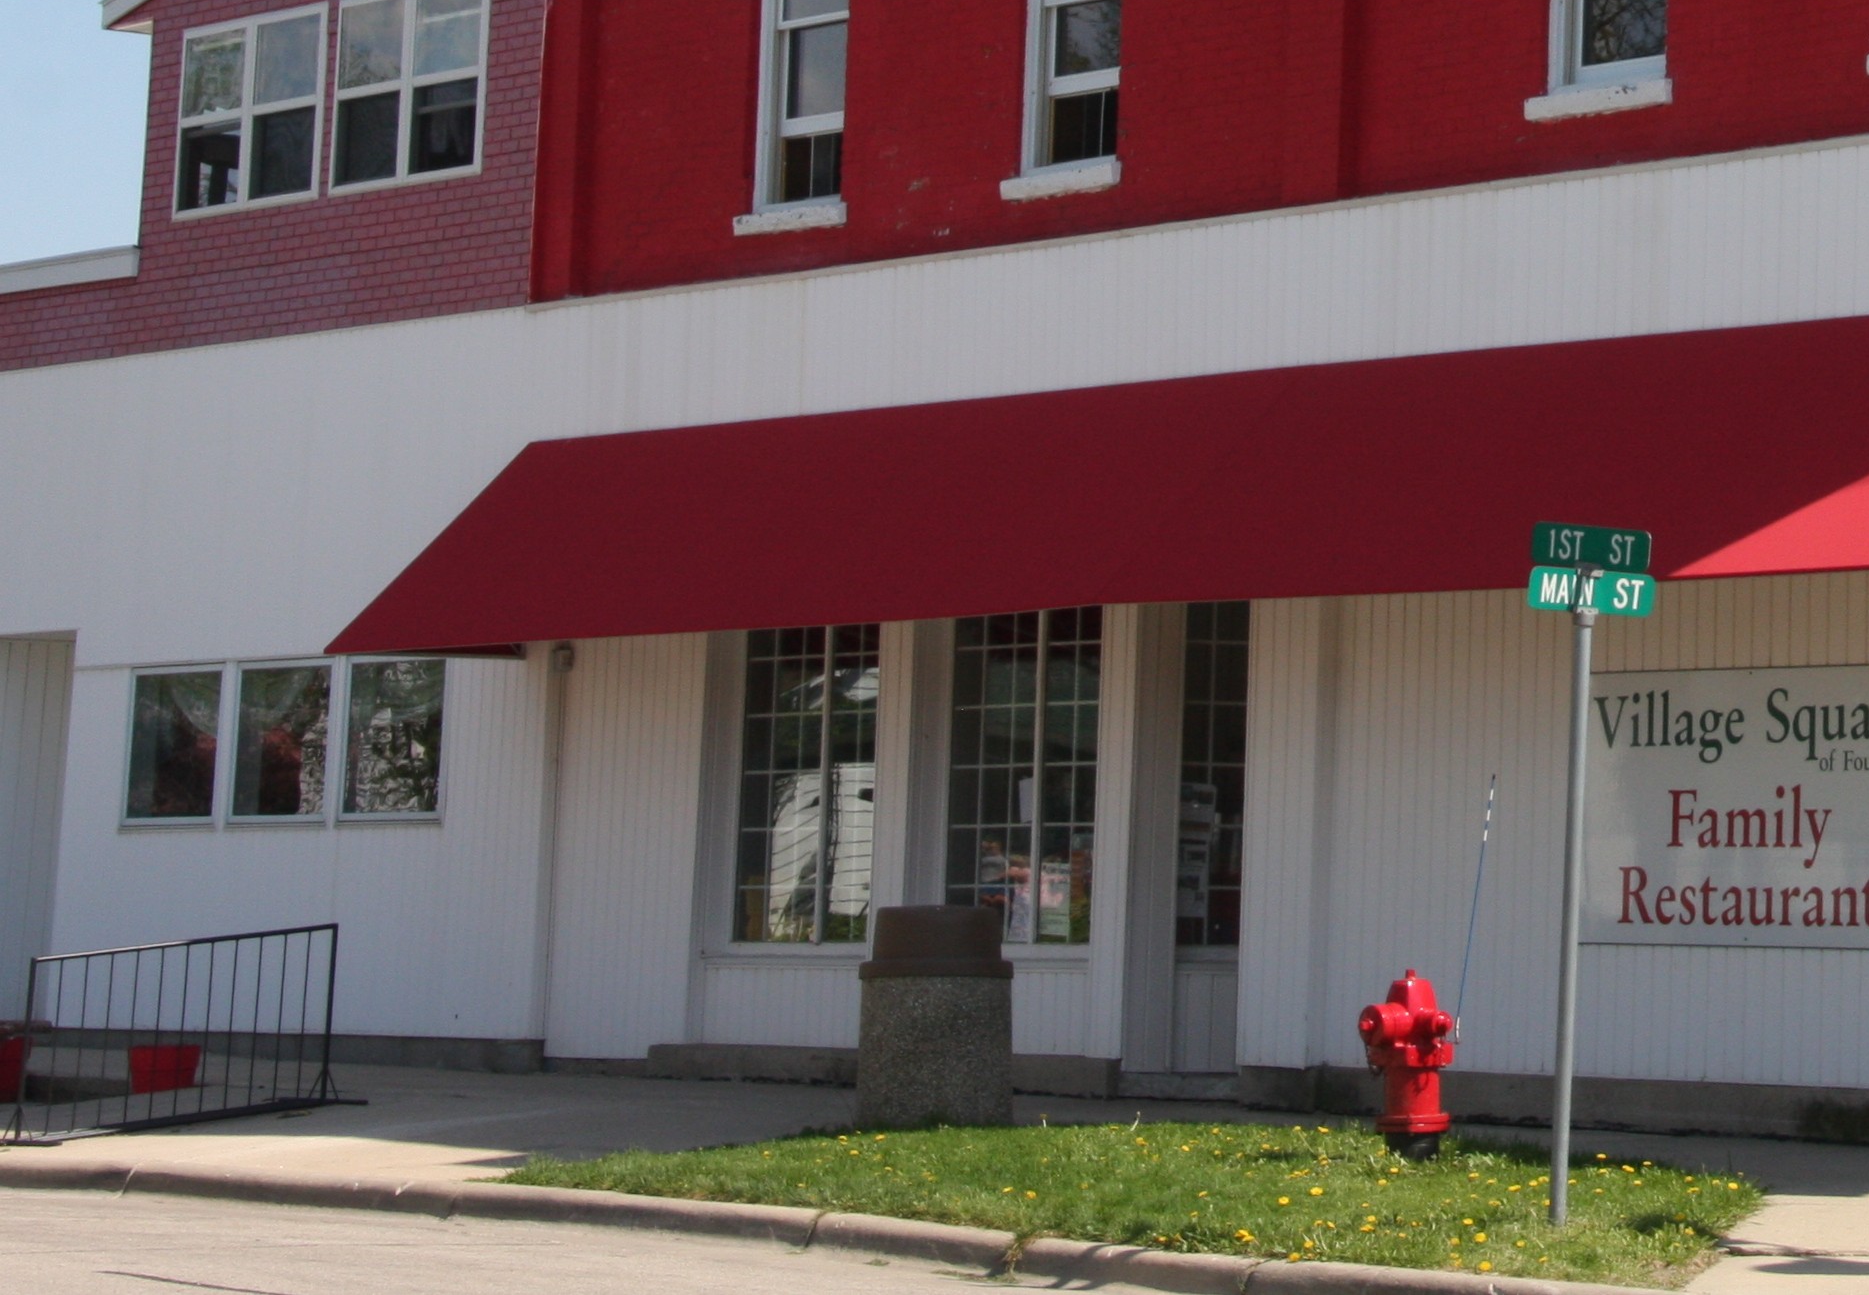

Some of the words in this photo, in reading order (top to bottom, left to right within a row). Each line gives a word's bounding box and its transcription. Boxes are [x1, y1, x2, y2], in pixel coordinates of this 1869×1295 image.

[1549, 528, 1585, 561] 1ST
[1609, 533, 1635, 566] ST
[1613, 578, 1645, 610] ST
[1593, 690, 1745, 764] Village
[1818, 749, 1839, 772] of
[1667, 784, 1832, 869] Family
